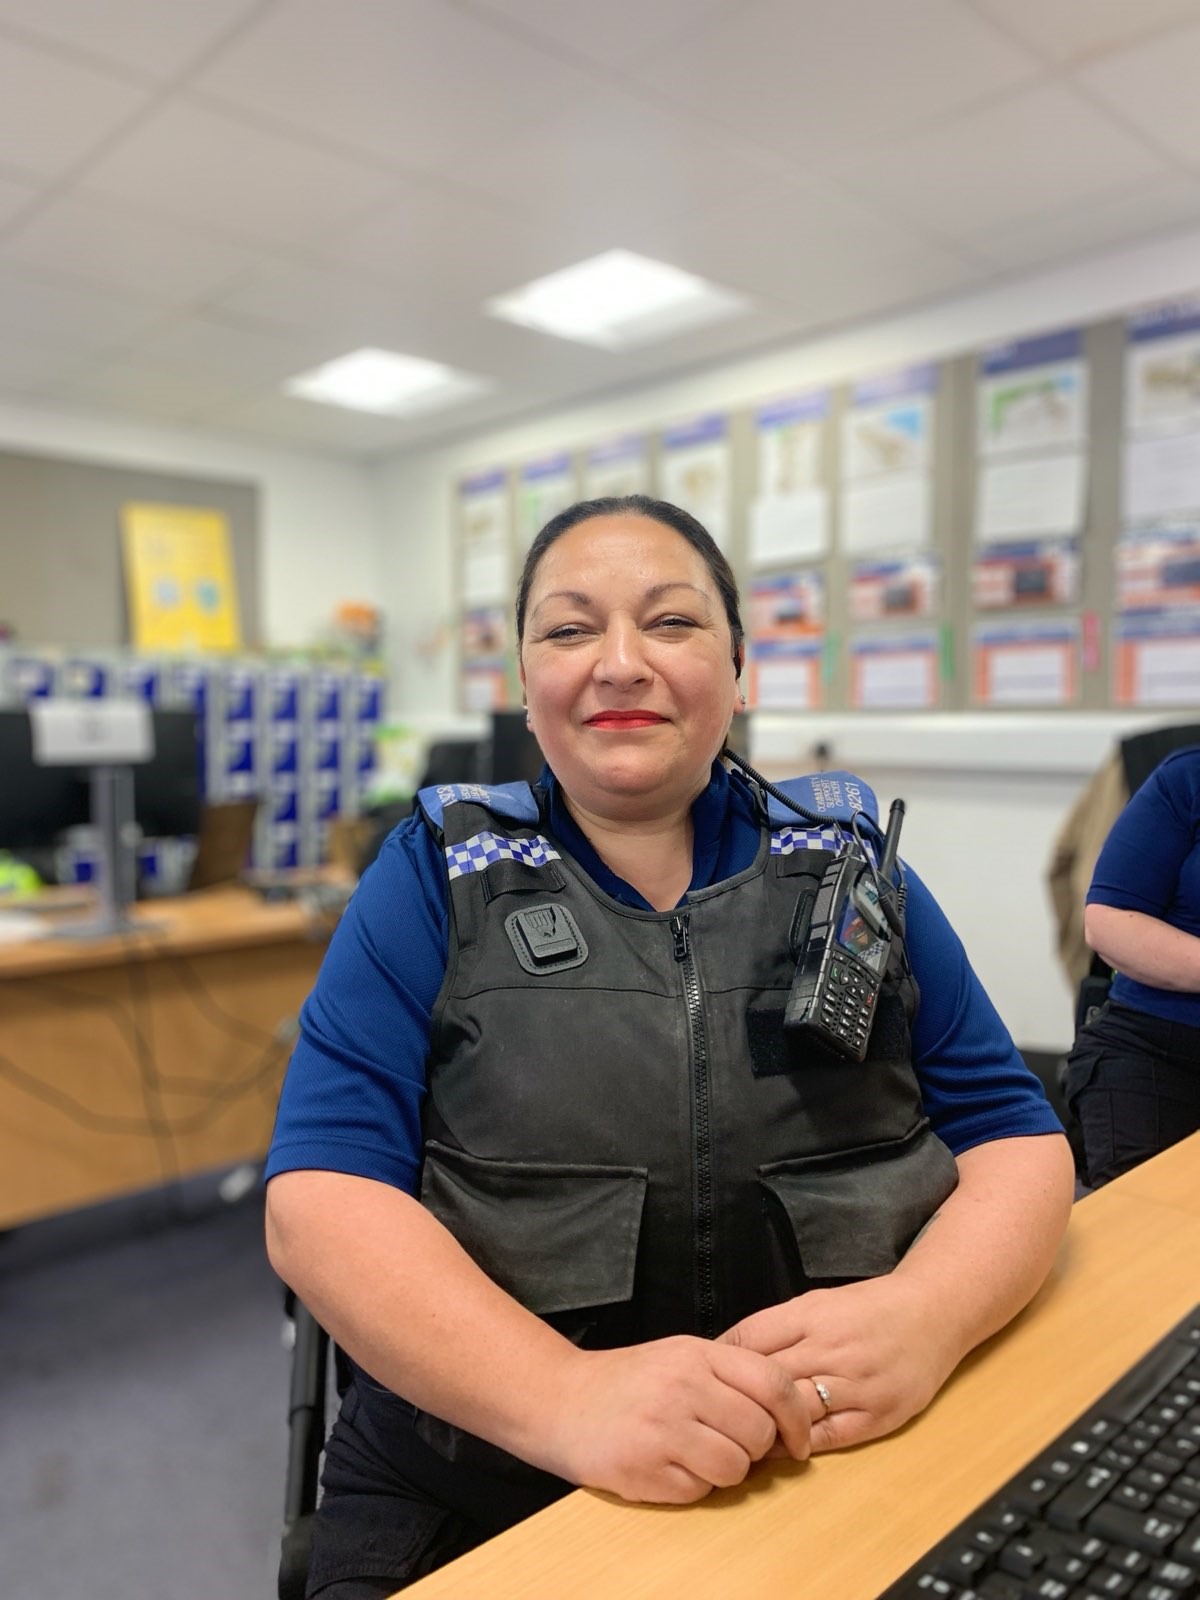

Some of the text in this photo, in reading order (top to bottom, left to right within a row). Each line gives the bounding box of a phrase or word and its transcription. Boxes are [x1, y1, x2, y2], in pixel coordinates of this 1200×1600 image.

[810, 777, 826, 812] COMMUNITY
[821, 779, 835, 808] SUPPORT
[830, 780, 844, 807] OFFICER
[844, 782, 863, 811] 8261
